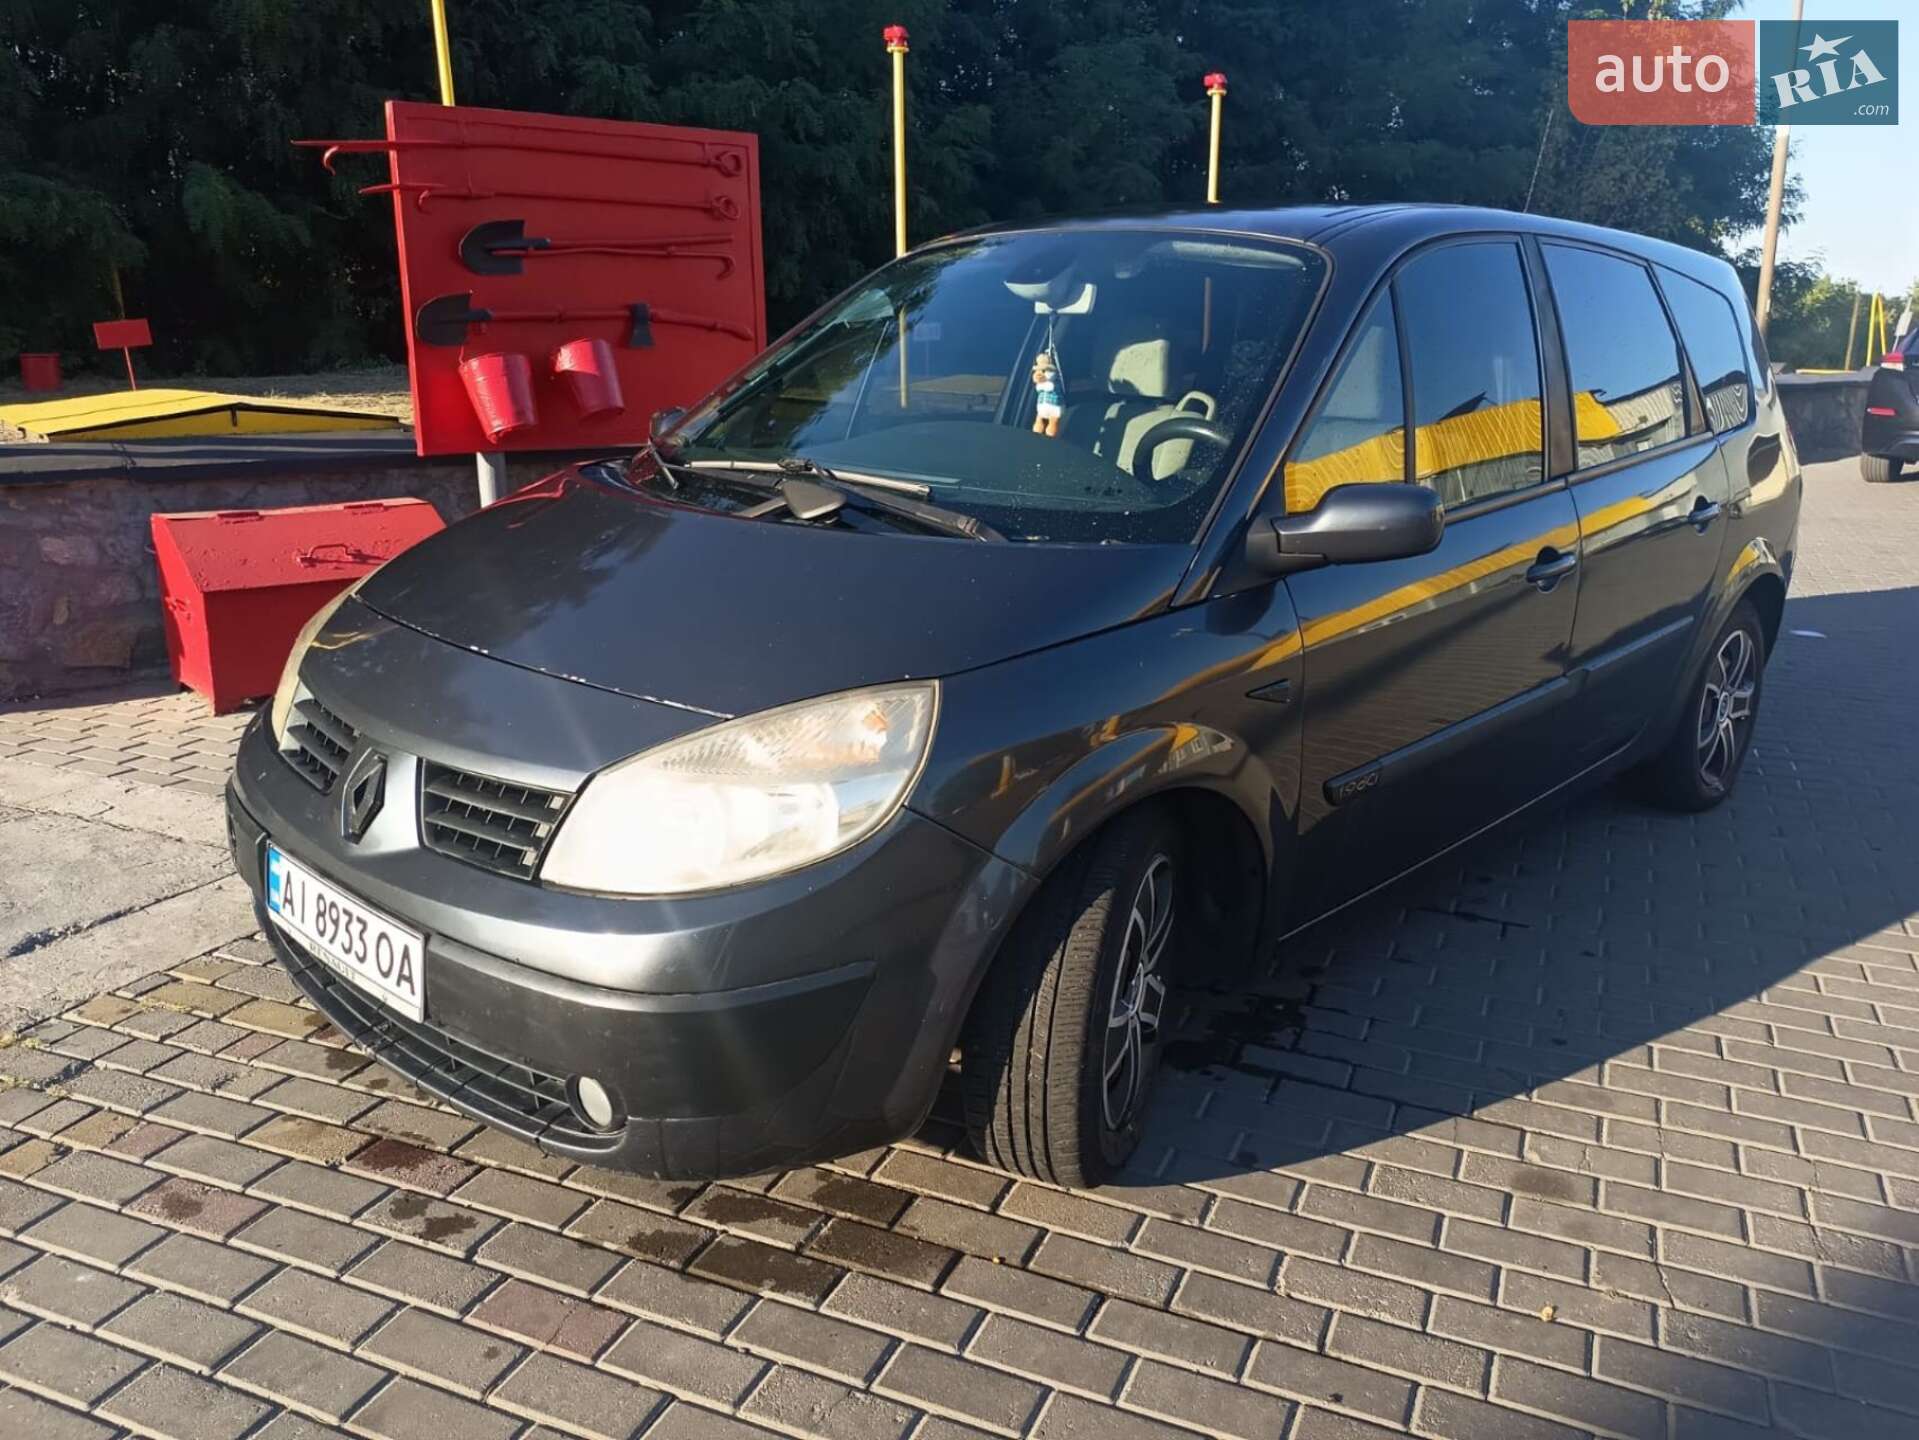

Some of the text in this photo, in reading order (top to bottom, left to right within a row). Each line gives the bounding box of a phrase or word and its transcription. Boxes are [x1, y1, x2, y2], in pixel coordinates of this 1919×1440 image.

[282, 870, 416, 996] AI 8933 OA
